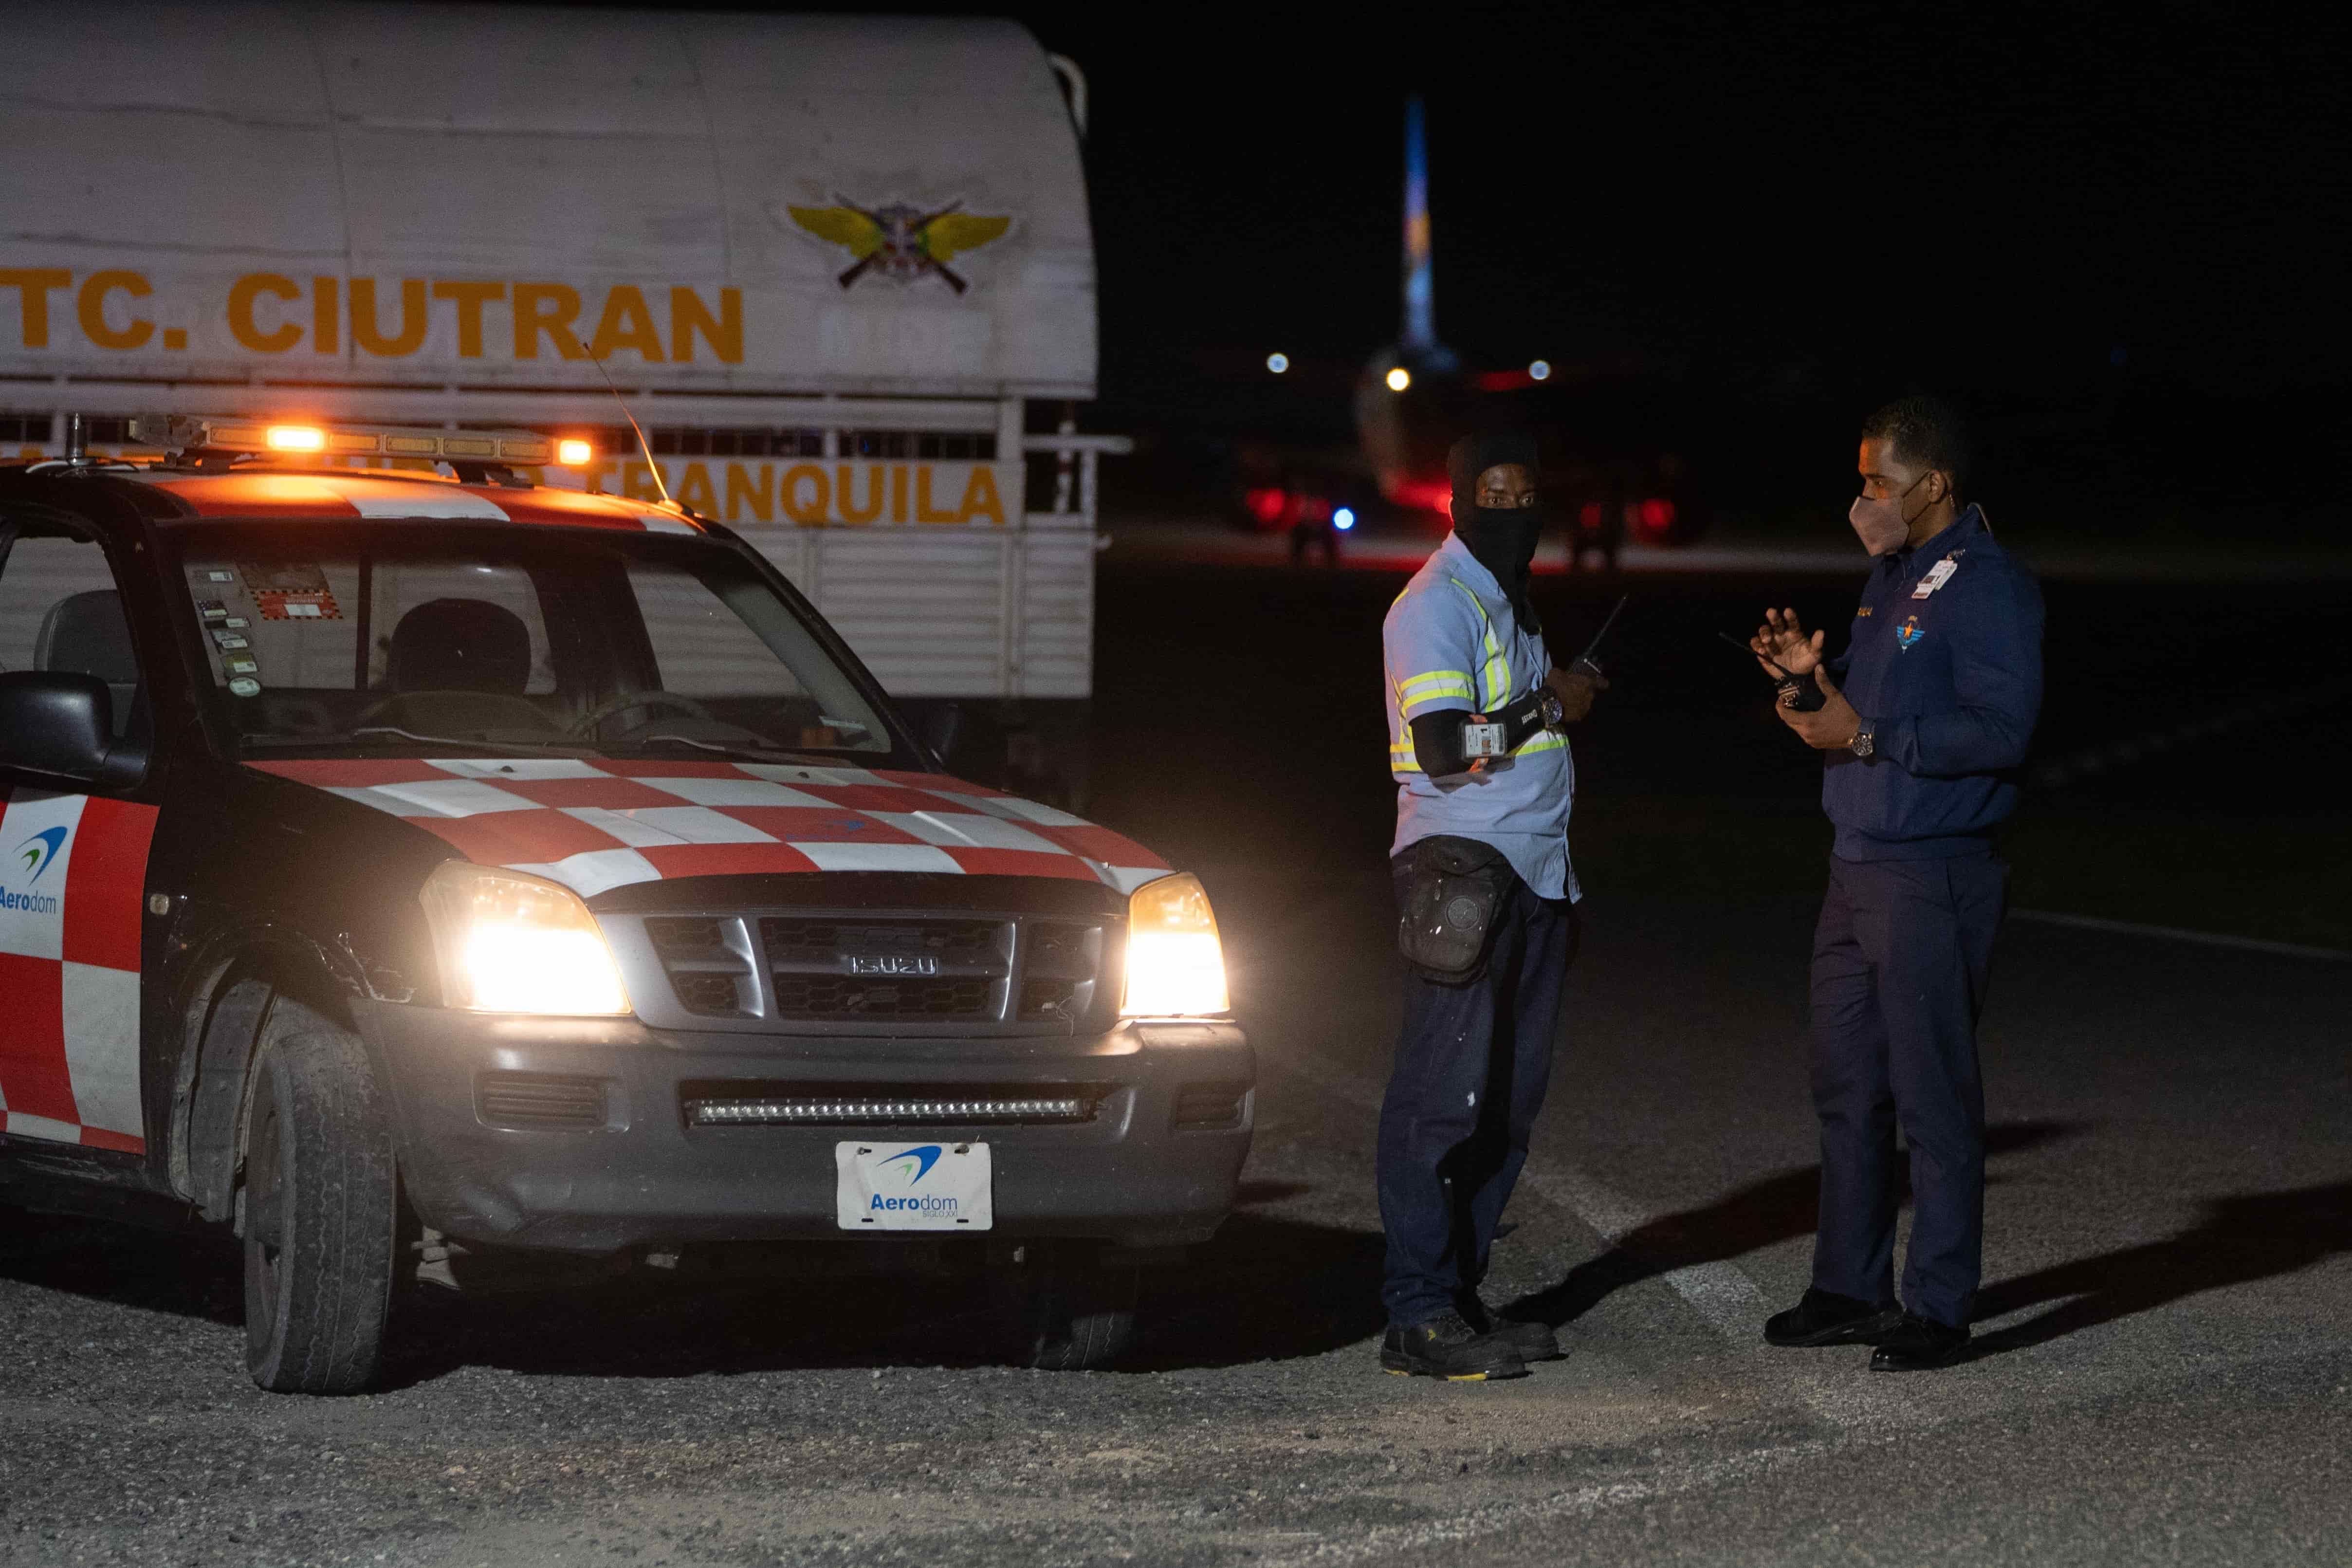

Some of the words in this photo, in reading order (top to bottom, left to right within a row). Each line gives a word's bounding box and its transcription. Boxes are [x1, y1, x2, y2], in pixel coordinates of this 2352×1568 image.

[0, 268, 187, 350] TC.
[228, 273, 743, 364] CIUTRAN
[568, 457, 1005, 525] TRANQUILA
[0, 886, 55, 914] Aerodom
[852, 957, 936, 974] ISUZU
[871, 1193, 957, 1210] Aerodom
